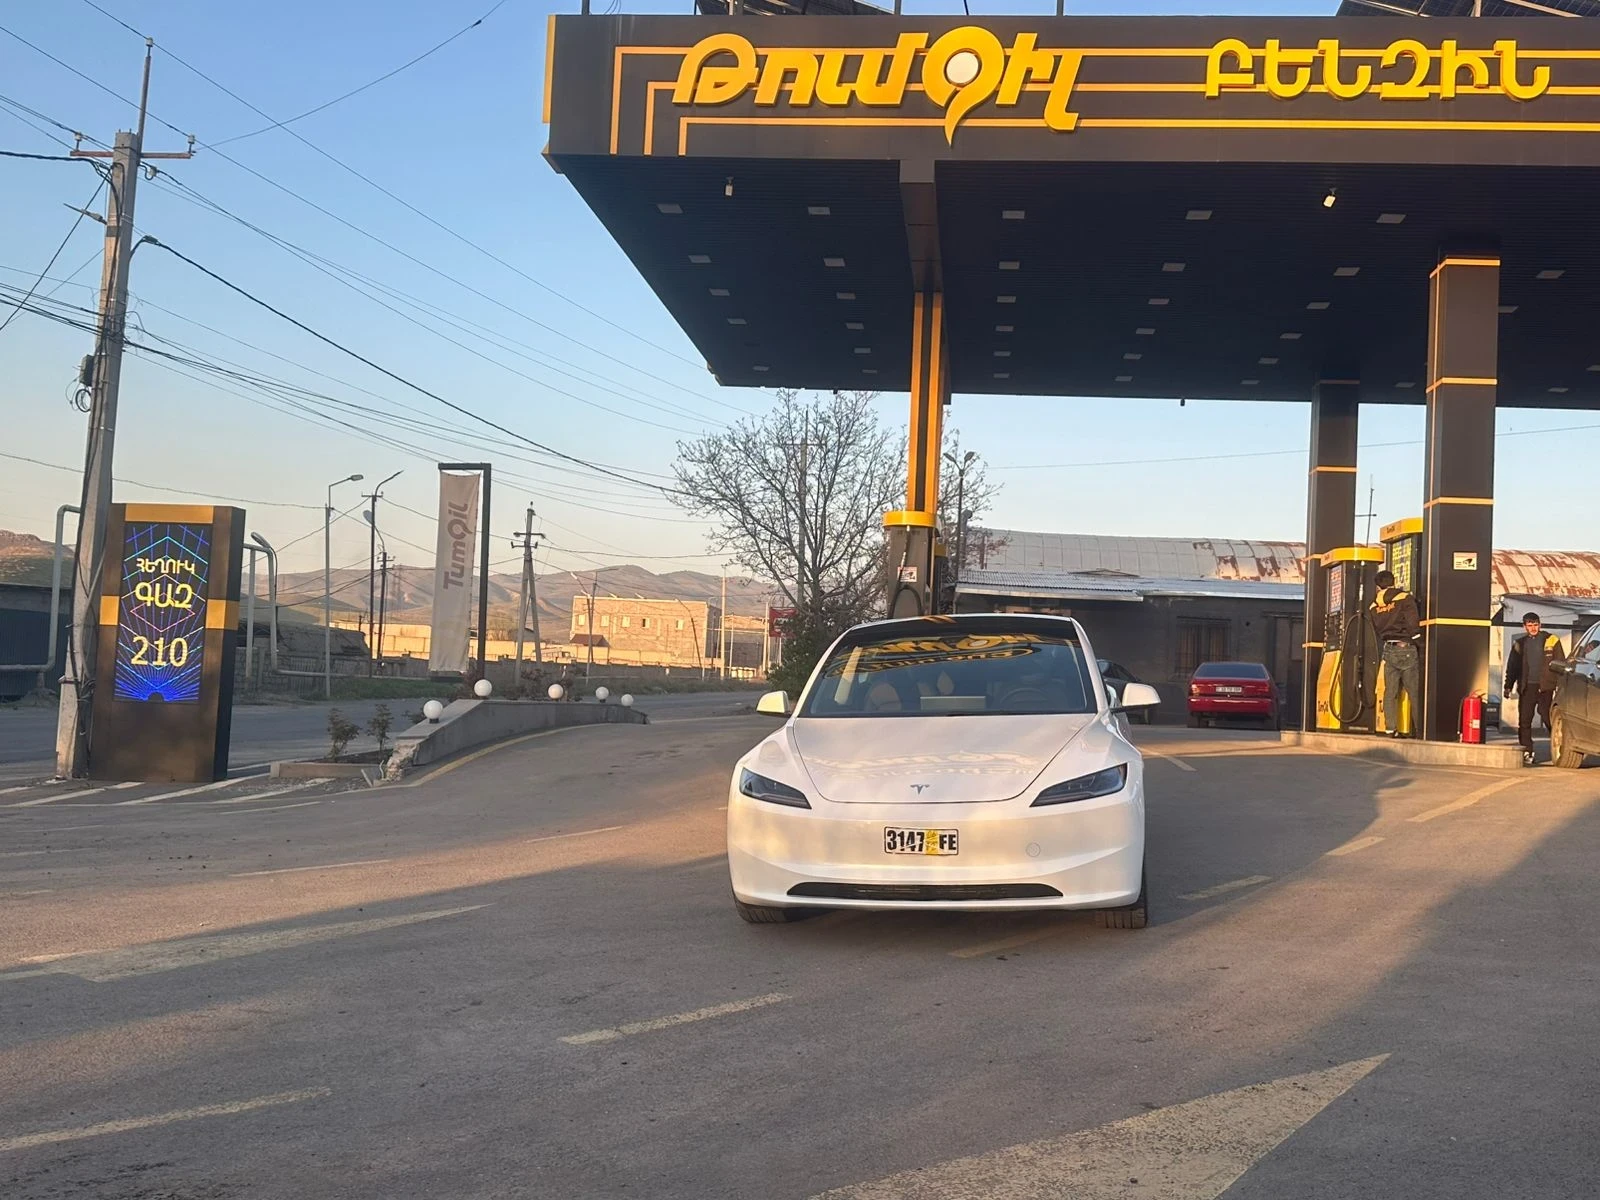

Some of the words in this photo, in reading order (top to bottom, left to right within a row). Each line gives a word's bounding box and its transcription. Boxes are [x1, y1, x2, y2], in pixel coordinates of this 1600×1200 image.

[131, 636, 188, 667] 210
[886, 829, 925, 852] 3147
[938, 833, 957, 850] FE
